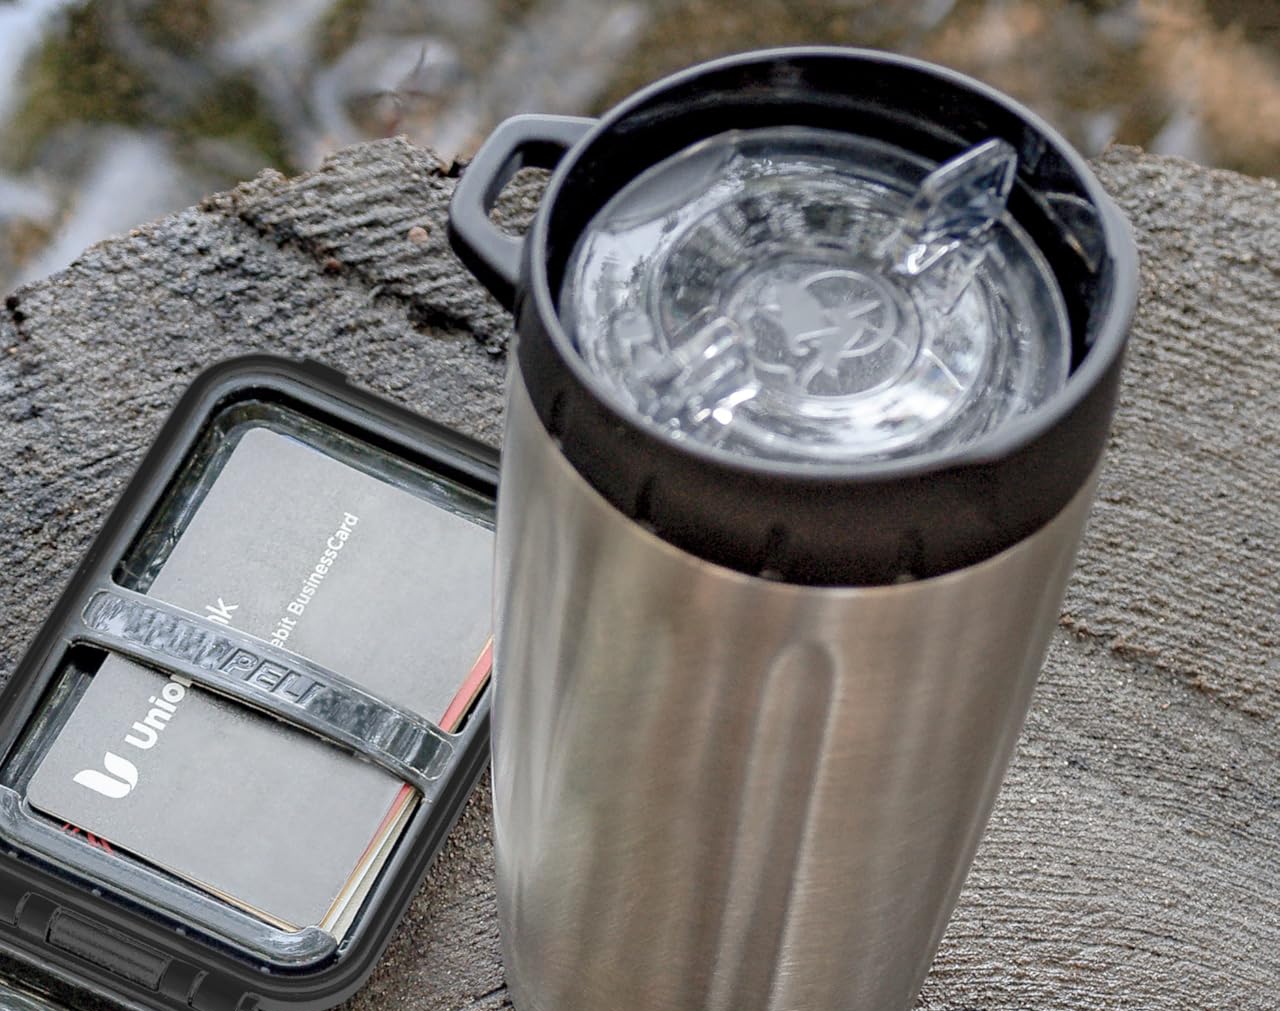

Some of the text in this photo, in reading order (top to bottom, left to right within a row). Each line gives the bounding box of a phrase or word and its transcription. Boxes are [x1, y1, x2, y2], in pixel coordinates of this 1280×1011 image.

[270, 511, 360, 649] ebit BusinessCard
[218, 647, 327, 709] PELI
[124, 682, 186, 750] Unio
